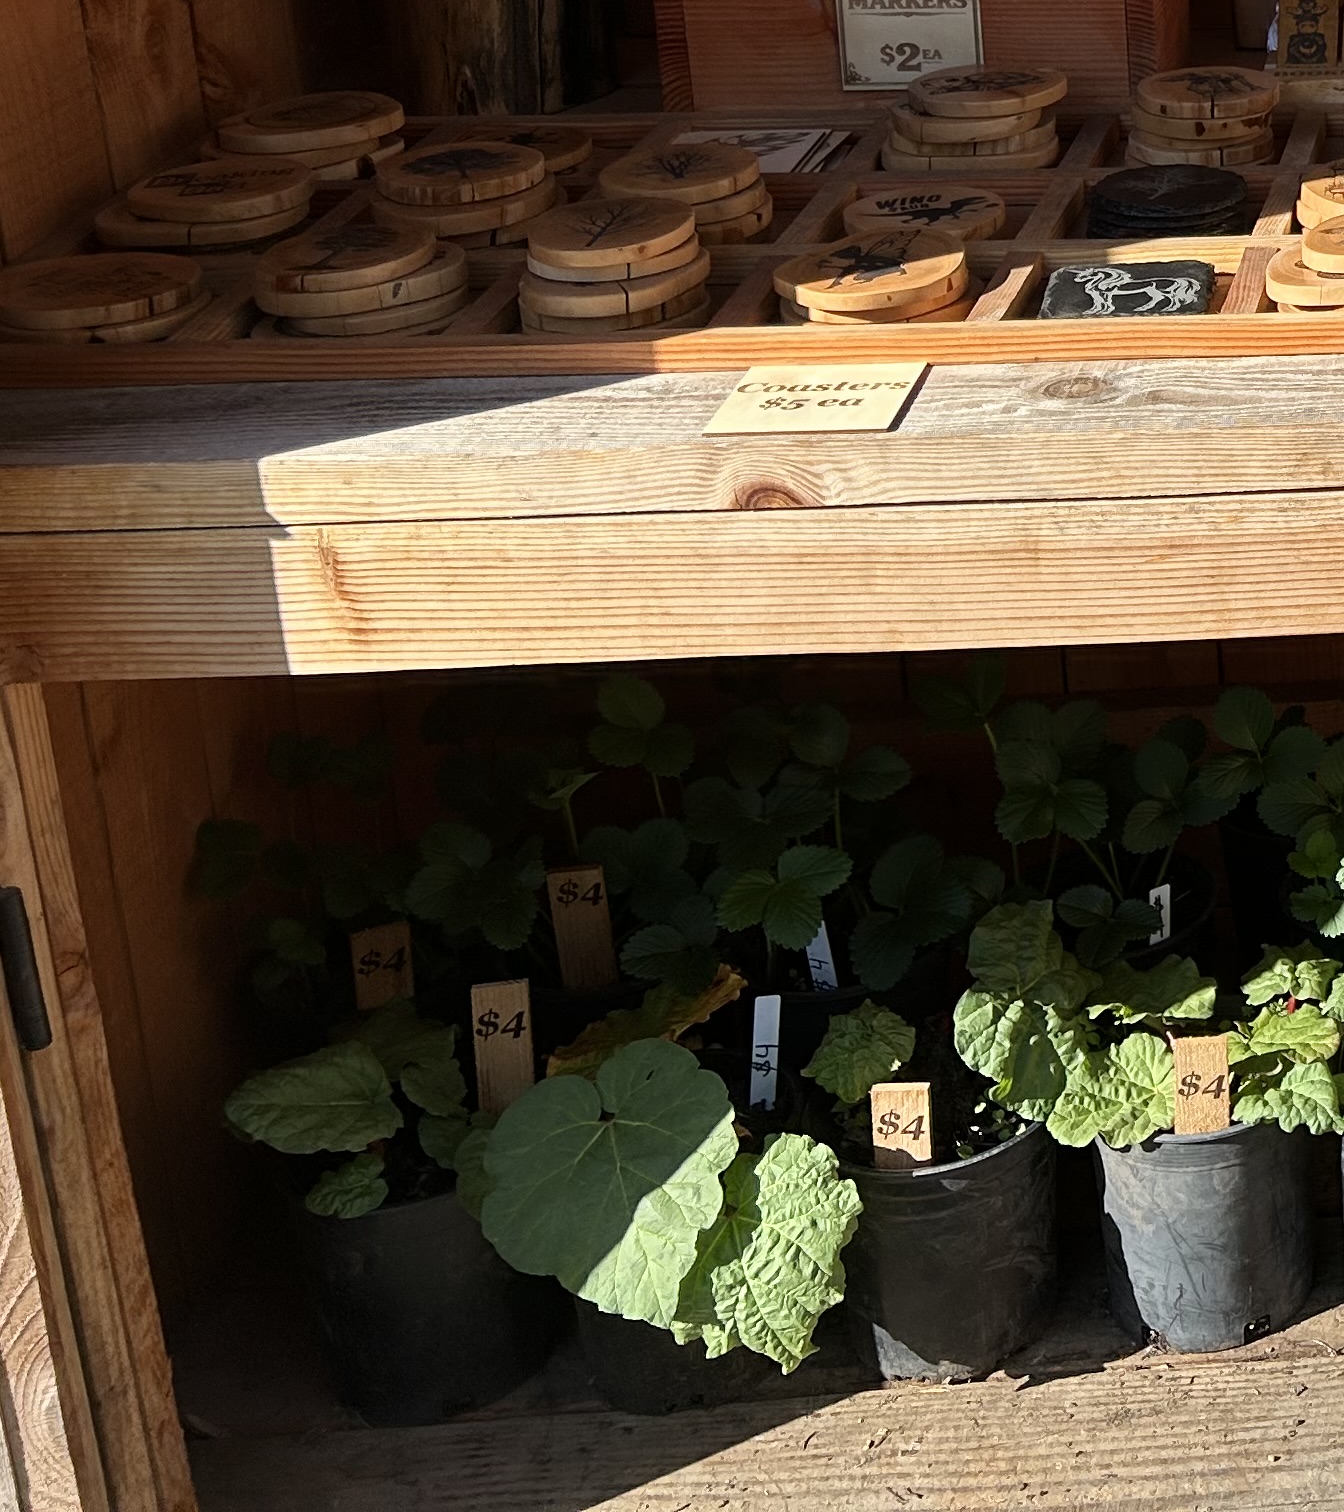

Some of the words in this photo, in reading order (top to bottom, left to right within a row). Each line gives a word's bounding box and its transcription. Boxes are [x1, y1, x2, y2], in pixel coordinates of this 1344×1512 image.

[879, 41, 922, 72] $2
[922, 48, 943, 61] EA
[875, 194, 942, 210] WINO
[737, 381, 911, 394] Coasters
[758, 396, 811, 411] $5
[816, 398, 865, 407] ea
[557, 878, 602, 908] $4
[357, 947, 407, 978] $4
[475, 1008, 527, 1042] $4
[1178, 1071, 1227, 1101] $4
[876, 1109, 927, 1143] $4
